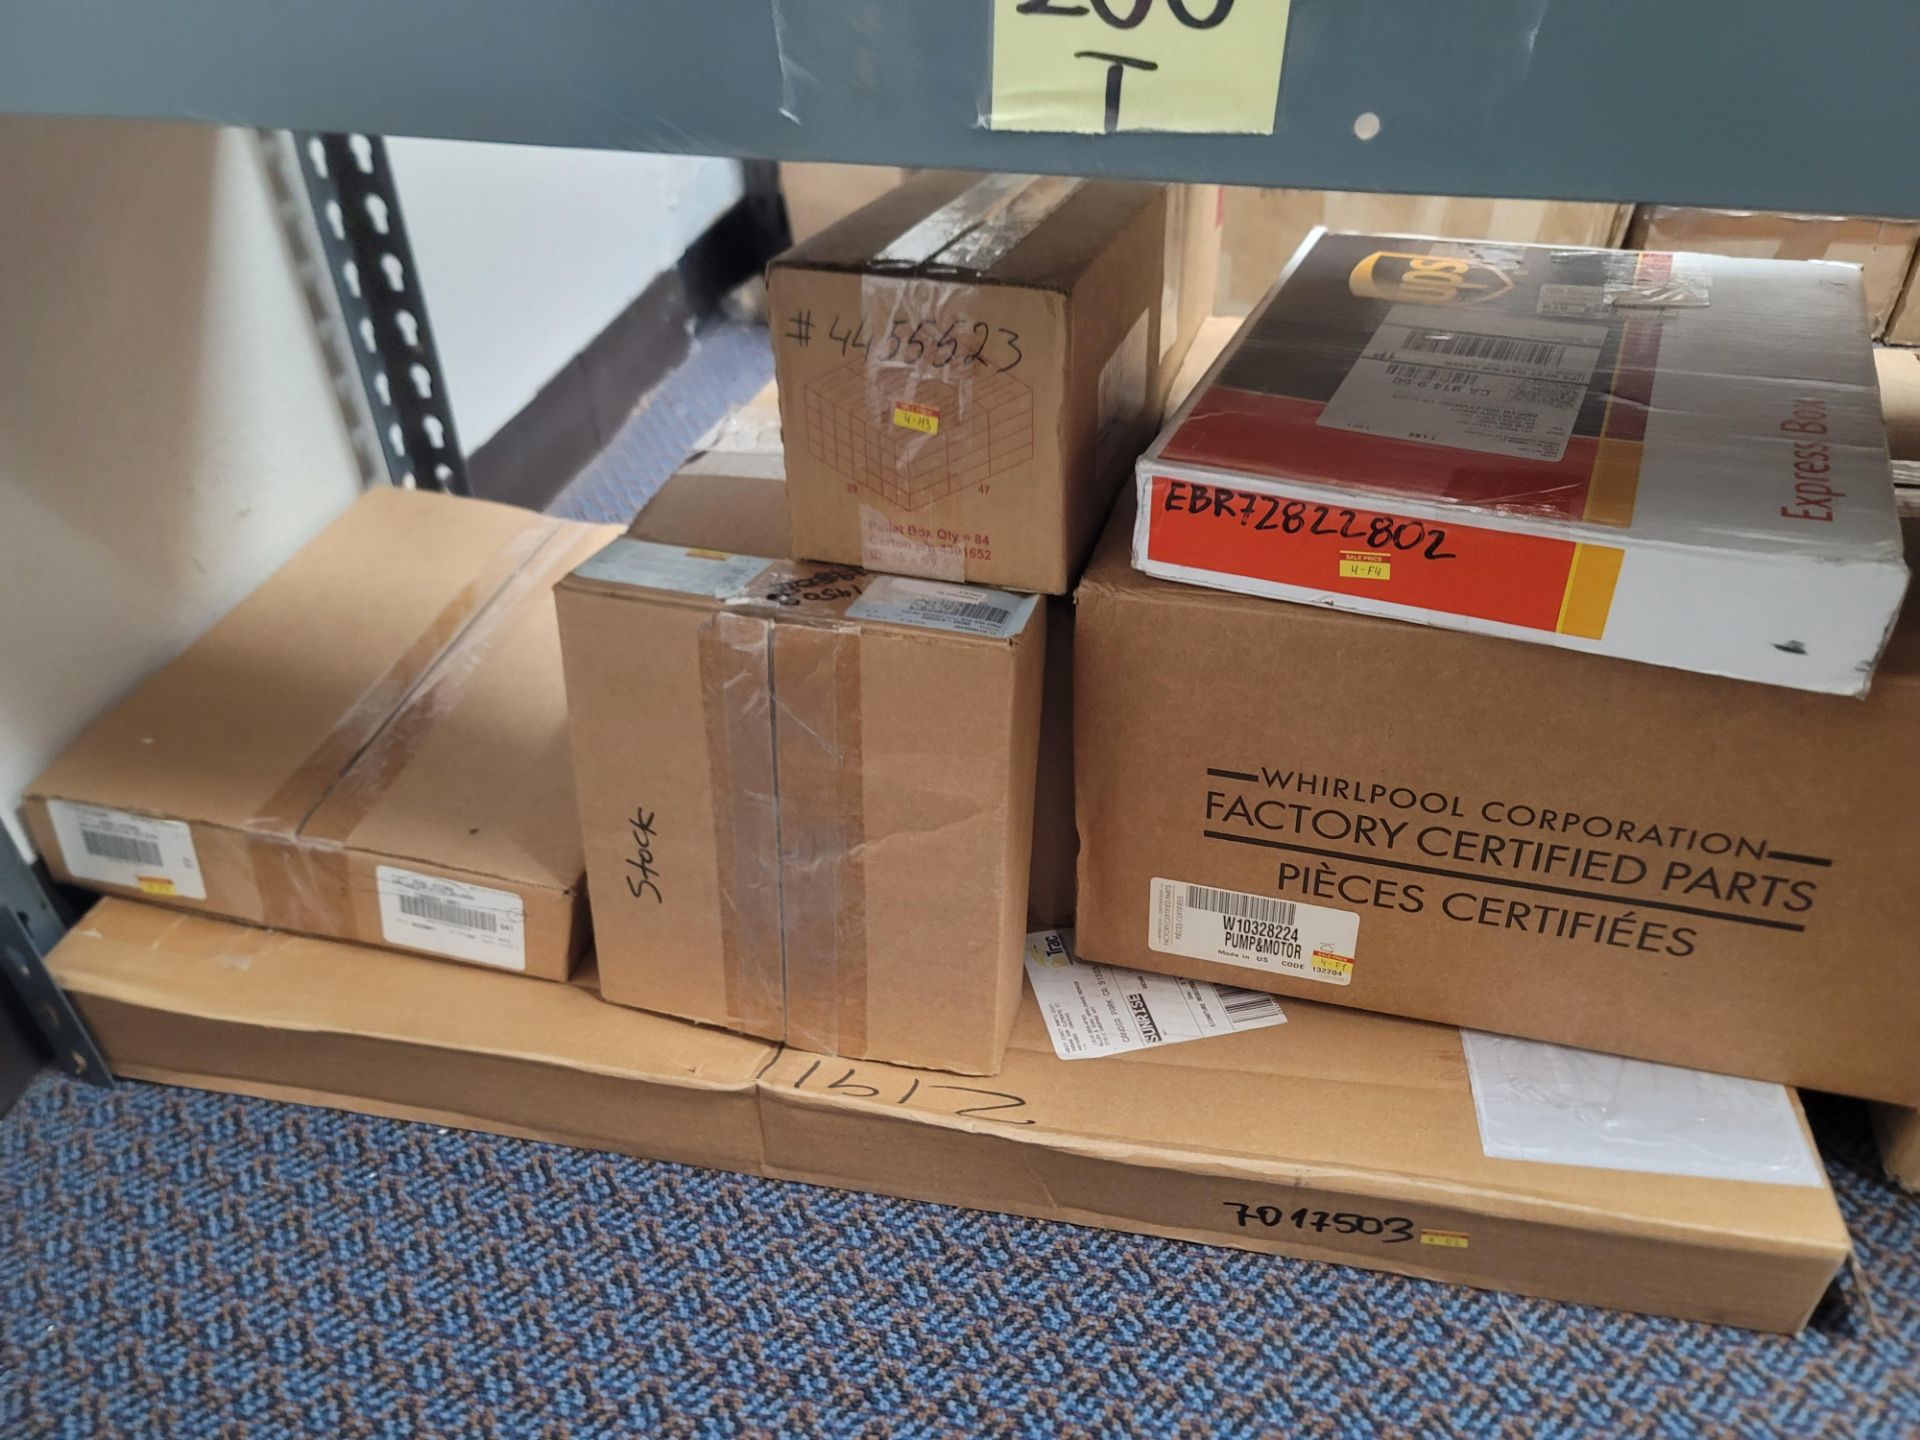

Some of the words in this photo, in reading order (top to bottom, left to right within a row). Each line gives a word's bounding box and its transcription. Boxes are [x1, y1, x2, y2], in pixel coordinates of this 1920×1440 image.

[1074, 51, 1158, 134] T
[1780, 399, 1828, 434] Box
[1780, 443, 1846, 522] Express
[908, 525, 931, 537] Box
[937, 528, 959, 543] Qty
[974, 535, 989, 546] 84
[1165, 481, 1455, 560] EBR72822802
[1261, 767, 1464, 818] WHIRLPOOL
[1481, 802, 1767, 861] CORPORATION
[625, 806, 662, 904] Stock
[1206, 791, 1408, 848] FACTORY
[1417, 827, 1647, 884] CERTIFIED
[1662, 861, 1817, 912] PARTS
[1223, 915, 1299, 943] W10328224
[1278, 862, 1424, 913] PIÈCES
[1442, 893, 1697, 957] CERTIFIÉES
[1218, 949, 1239, 958] Made
[1256, 956, 1269, 964] US
[1281, 960, 1304, 970] CODE
[1225, 932, 1302, 960] PUMP&MOTOR
[1106, 998, 1118, 1015] PARK
[1129, 994, 1161, 1044] SUNRISE
[1222, 1201, 1414, 1244] 7017503
